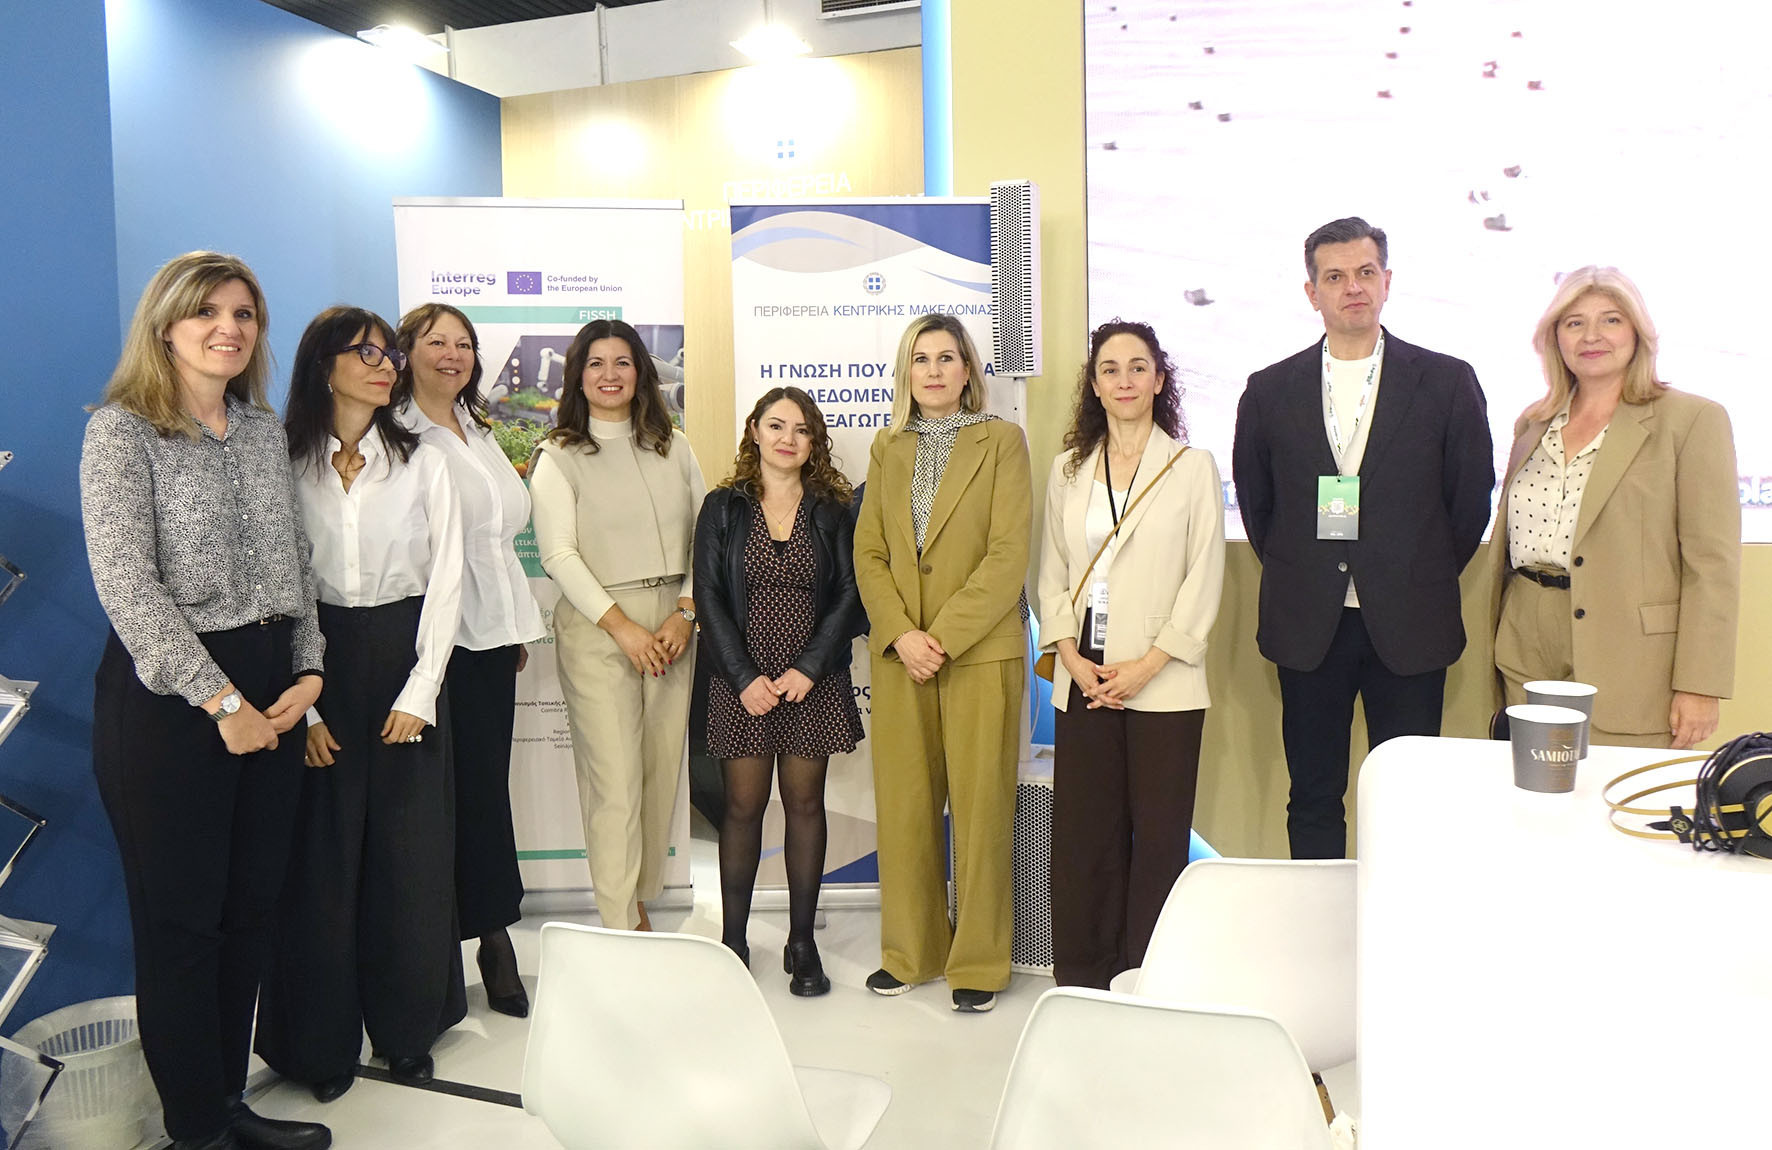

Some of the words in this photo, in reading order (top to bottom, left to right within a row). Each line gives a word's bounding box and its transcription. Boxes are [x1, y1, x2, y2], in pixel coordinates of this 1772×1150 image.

[723, 171, 852, 200] ΠΕΡΙΦΕΡΕΙΑ
[432, 270, 496, 285] Interreg
[547, 275, 587, 283] Co-funded
[589, 275, 598, 284] by
[432, 284, 481, 297] Europe
[561, 285, 598, 294] European
[579, 310, 616, 321] FISSH
[754, 305, 829, 317] ΠΕΡΙΦΕΡΕΙΑ
[833, 305, 905, 316] ΚΕΝΤΡΙΚΗΣ
[909, 304, 993, 316] ΜΑΚΕΔΟΝΙΑΣ
[779, 364, 842, 378] ΓΝΩΣΗ
[848, 363, 887, 377] ΠΟΥ
